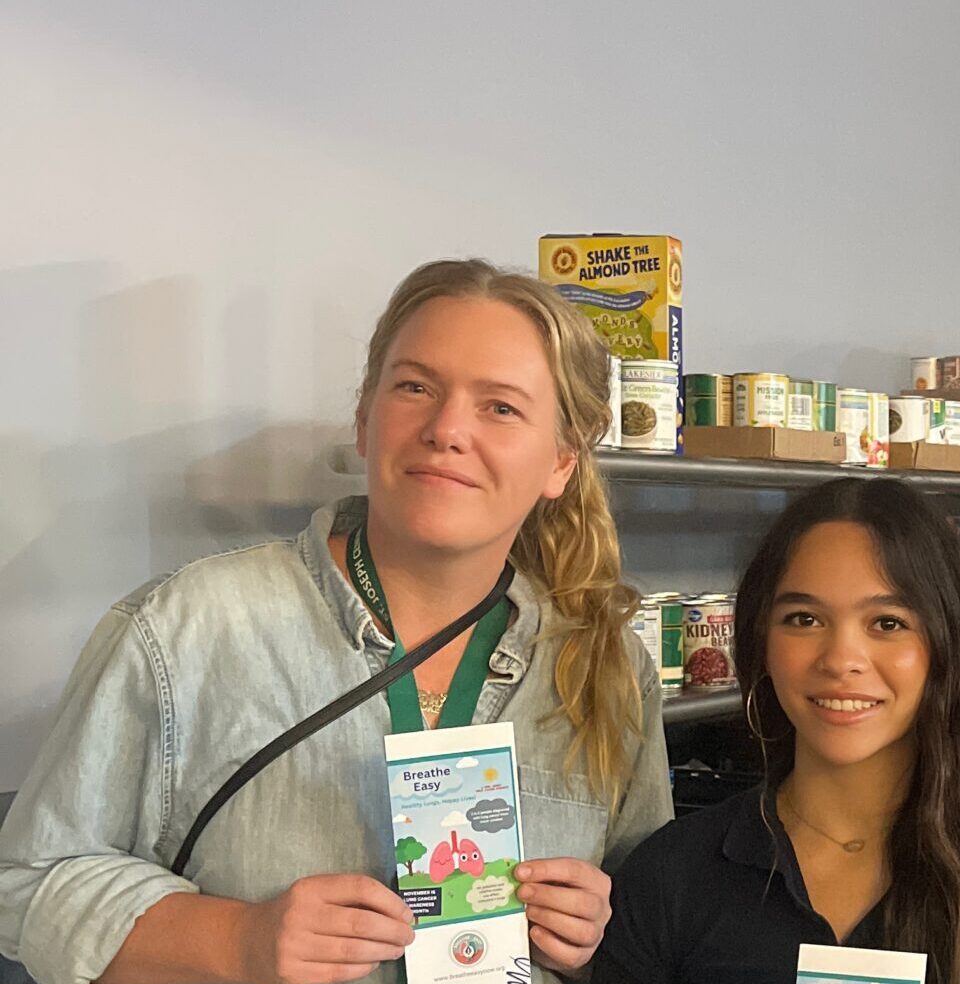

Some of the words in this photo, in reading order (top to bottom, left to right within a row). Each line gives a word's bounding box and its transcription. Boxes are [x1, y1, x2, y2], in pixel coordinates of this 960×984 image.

[587, 246, 631, 265] SHAKE
[633, 245, 649, 255] THE
[579, 262, 630, 281] ALMOND
[632, 257, 660, 273] TREE
[353, 559, 380, 604] JOSEPH
[403, 767, 451, 781] Breathe
[413, 781, 441, 792] Easy
